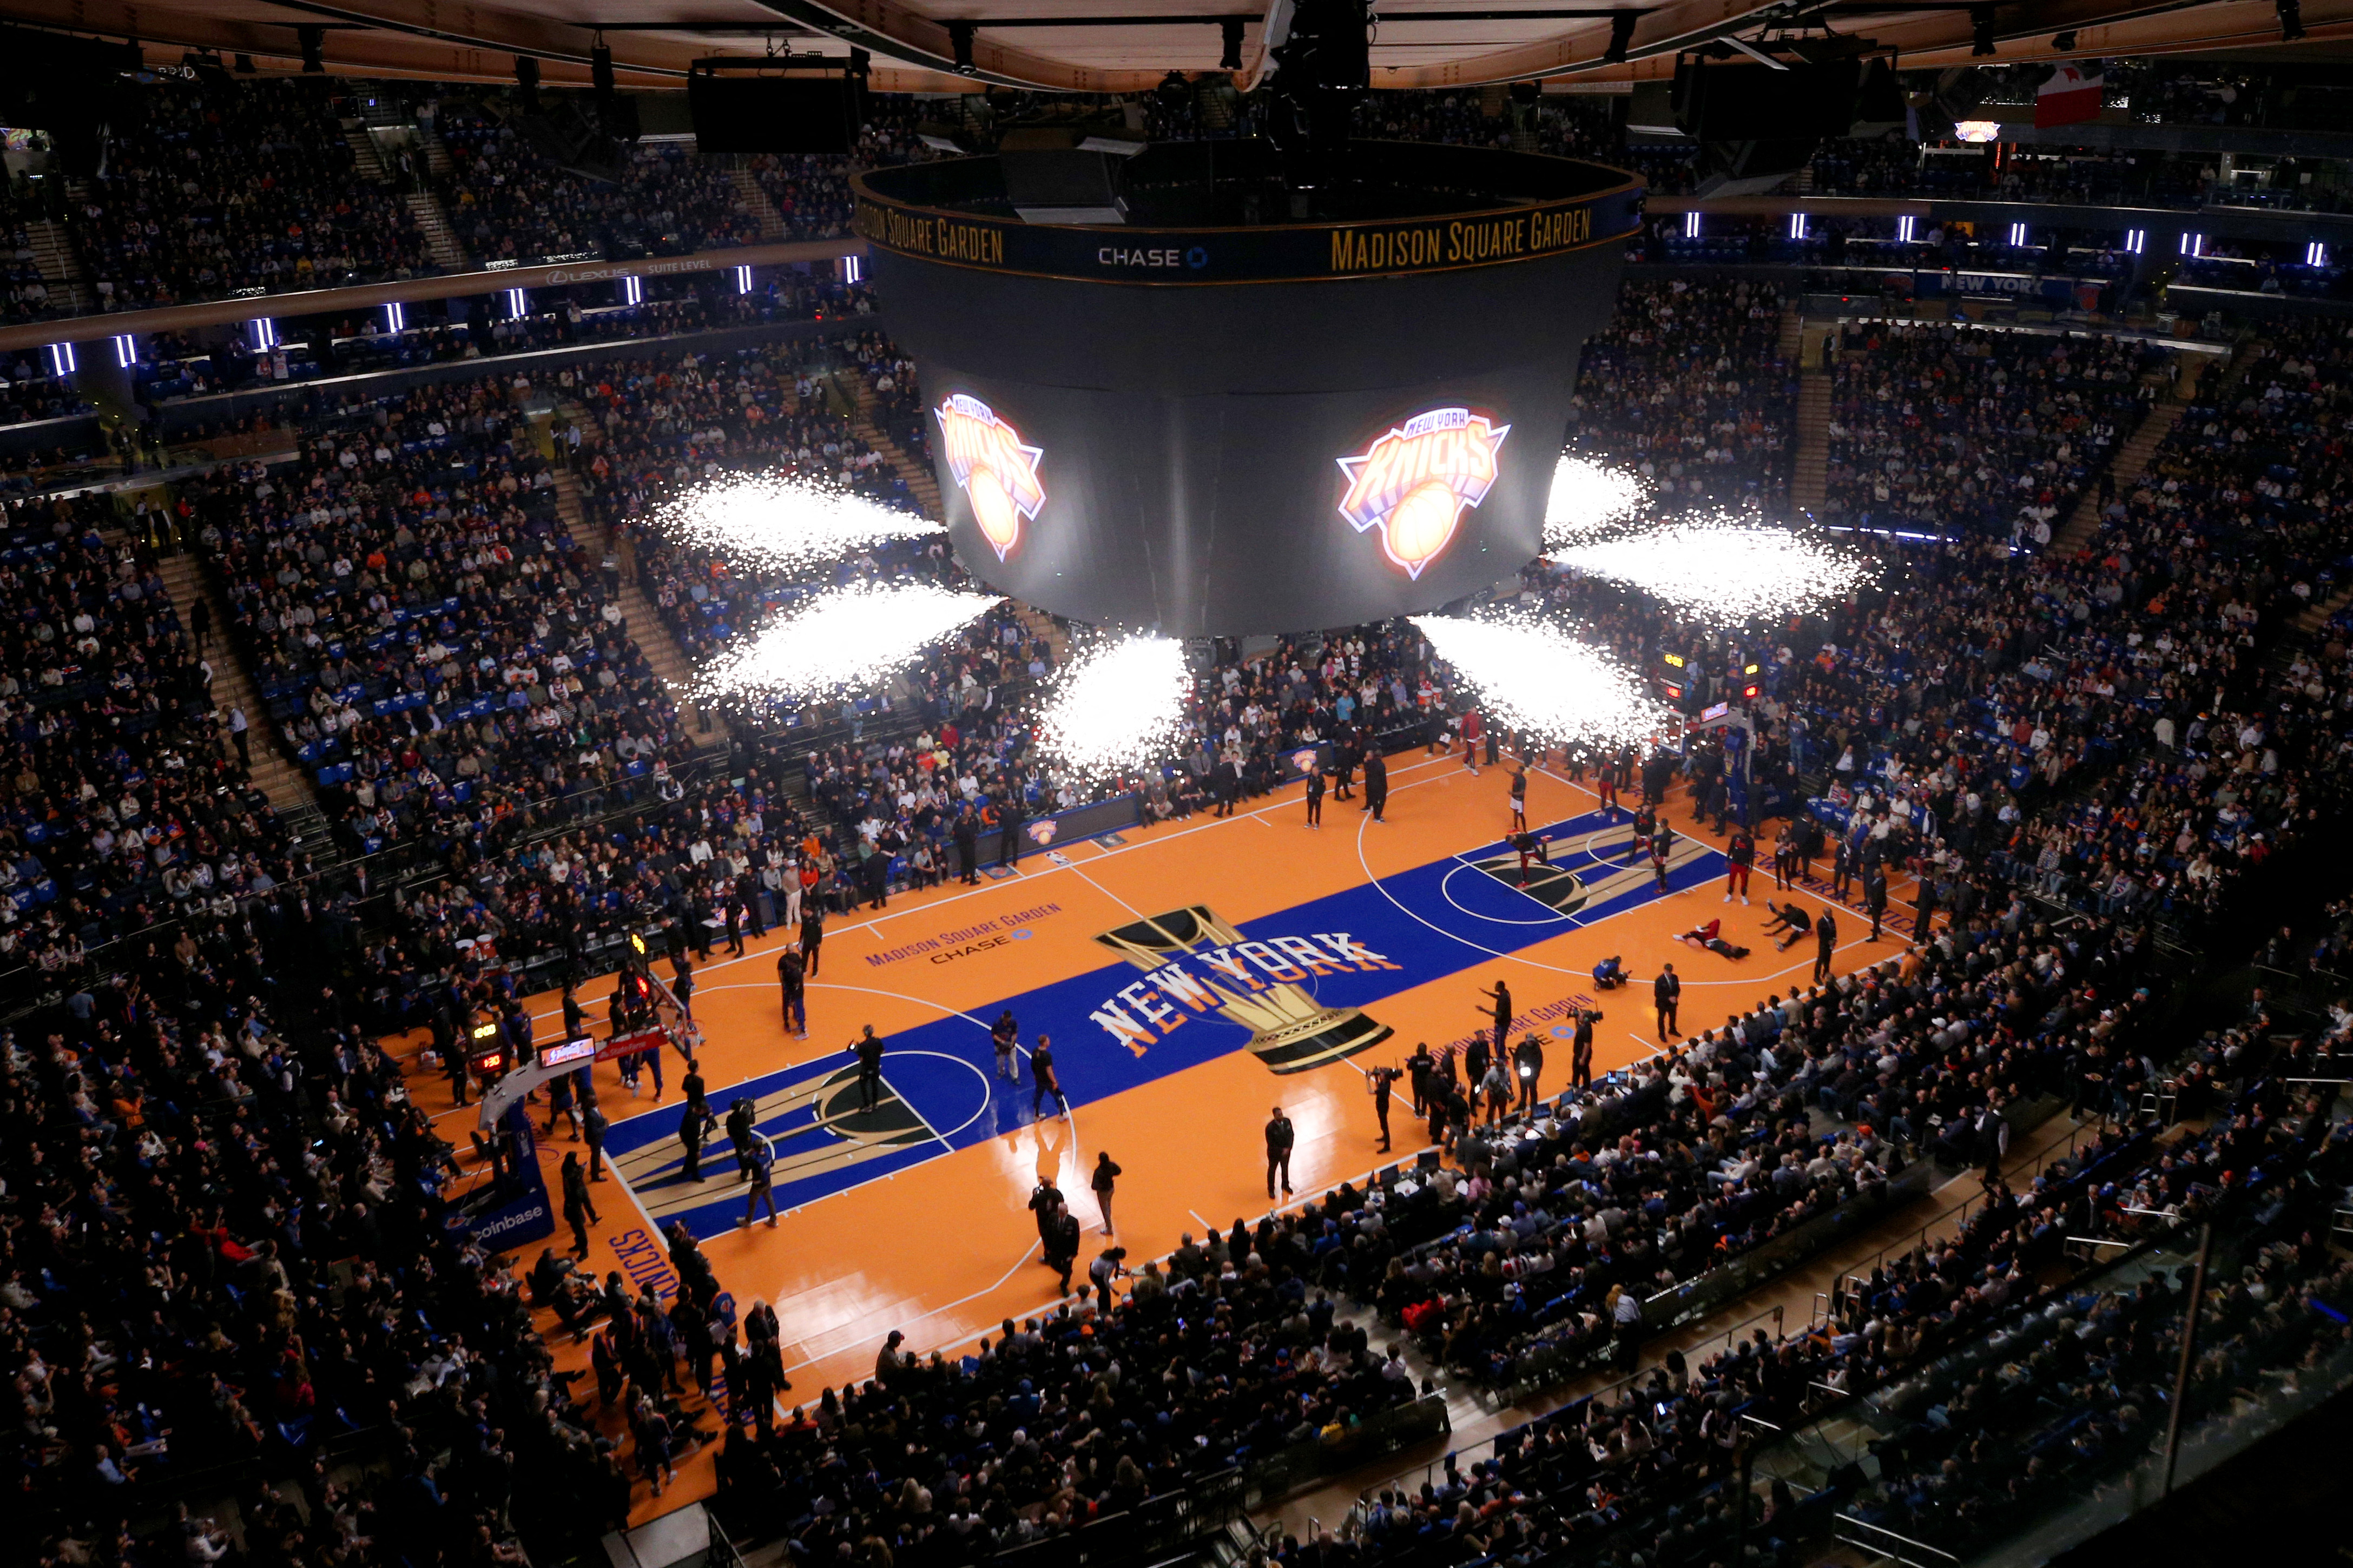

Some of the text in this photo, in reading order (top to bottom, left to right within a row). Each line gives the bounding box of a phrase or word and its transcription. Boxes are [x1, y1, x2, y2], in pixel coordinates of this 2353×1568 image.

[888, 208, 933, 253] SQUARE
[938, 218, 1003, 263] GARDEN
[1331, 208, 1591, 271] MADISON SQUARE GARDEN
[569, 260, 711, 281] LEXUS SUITE LEVEL
[1098, 247, 1180, 267] CHASE
[1941, 275, 2044, 295] NEW YORK
[955, 399, 993, 425] NEW YORK
[1406, 412, 1466, 436] NEW YORK
[946, 407, 1040, 500] KNICKS
[1346, 421, 1494, 511] KNICKS
[865, 903, 1062, 967] MADISON SQUARE GARDEN
[931, 936, 1010, 964] CHASE
[1089, 933, 1387, 1047] NEW YORK
[1531, 994, 1594, 1021] GARDEN
